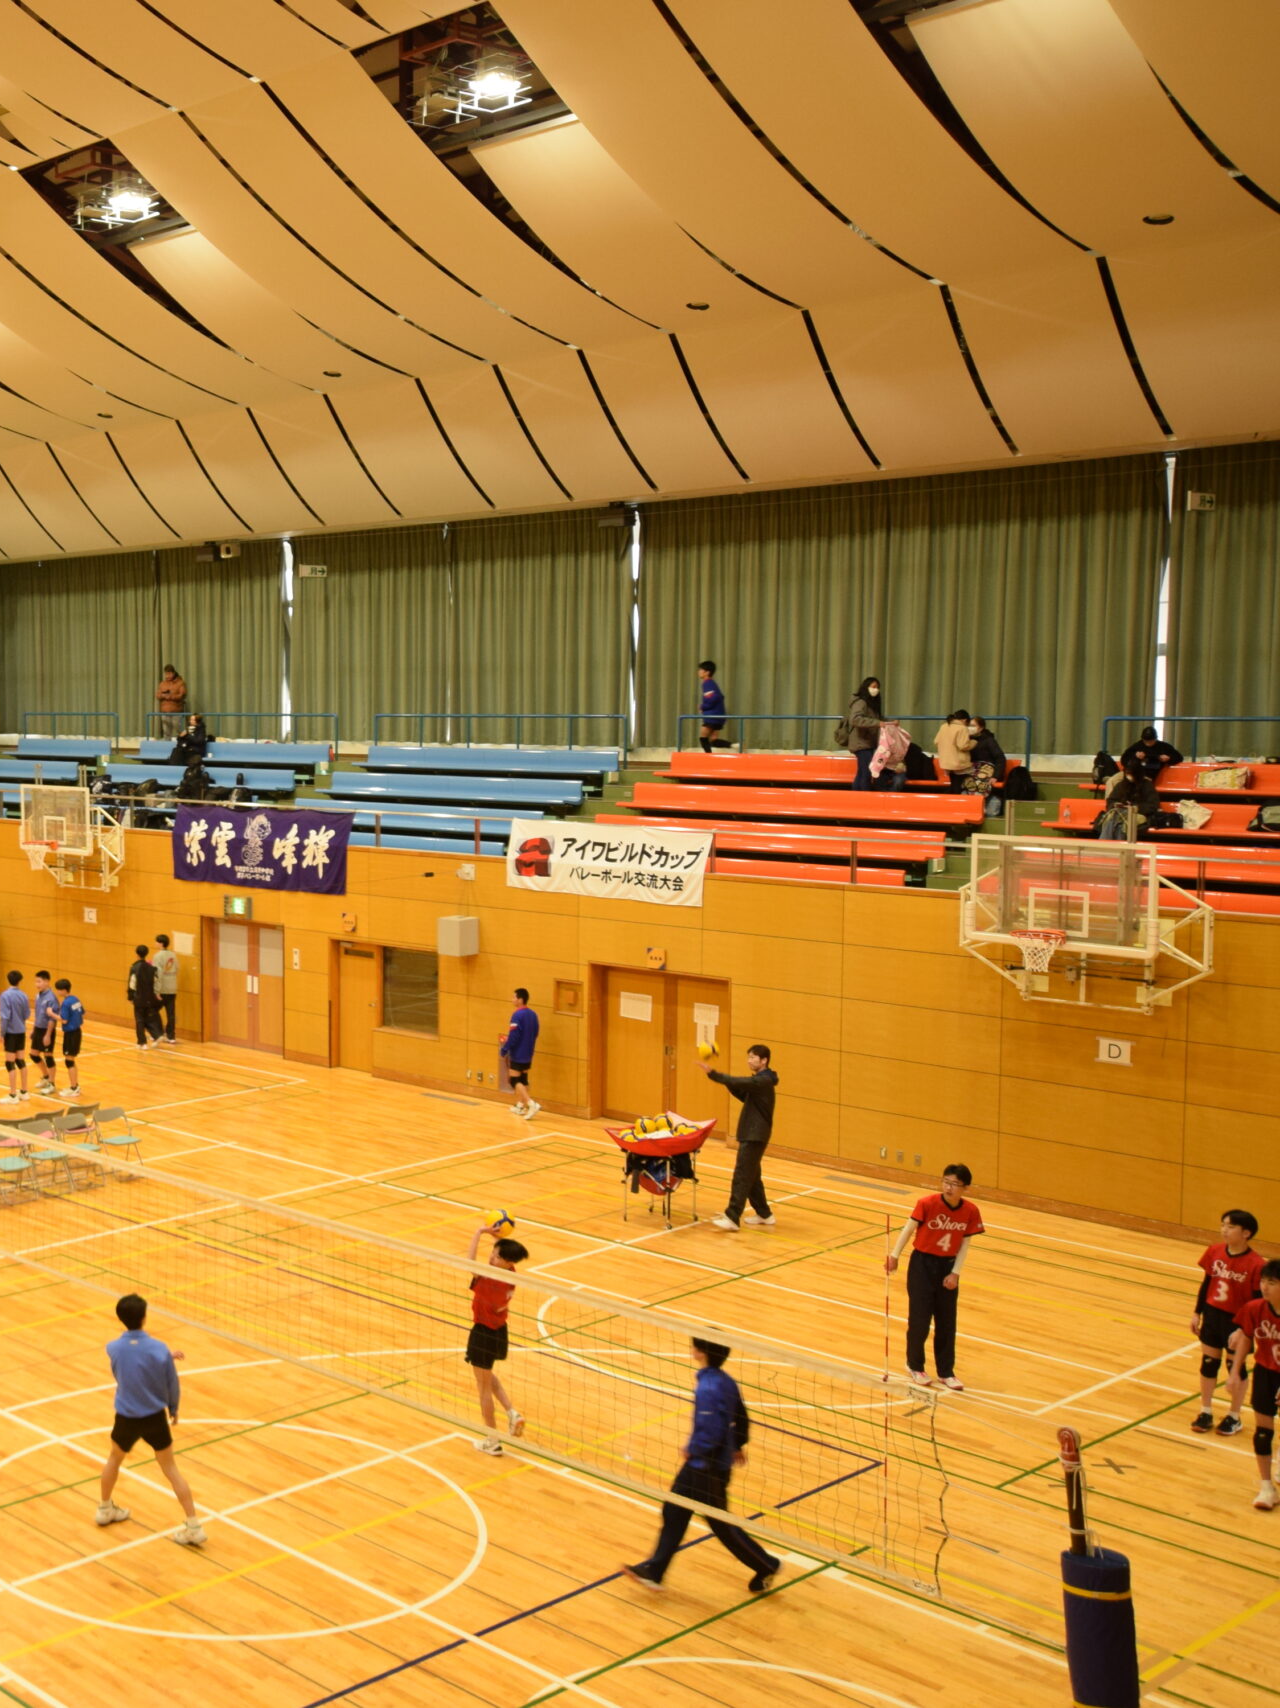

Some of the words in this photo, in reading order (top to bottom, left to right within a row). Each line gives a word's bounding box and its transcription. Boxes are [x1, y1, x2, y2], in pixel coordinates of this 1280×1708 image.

[560, 837, 705, 870] アイワビルドカップ
[569, 866, 685, 892] バレーボール交流大会
[1108, 1043, 1122, 1059] D
[936, 1233, 952, 1252] 4
[1211, 1259, 1248, 1283] Shoei
[1213, 1280, 1229, 1302] 3
